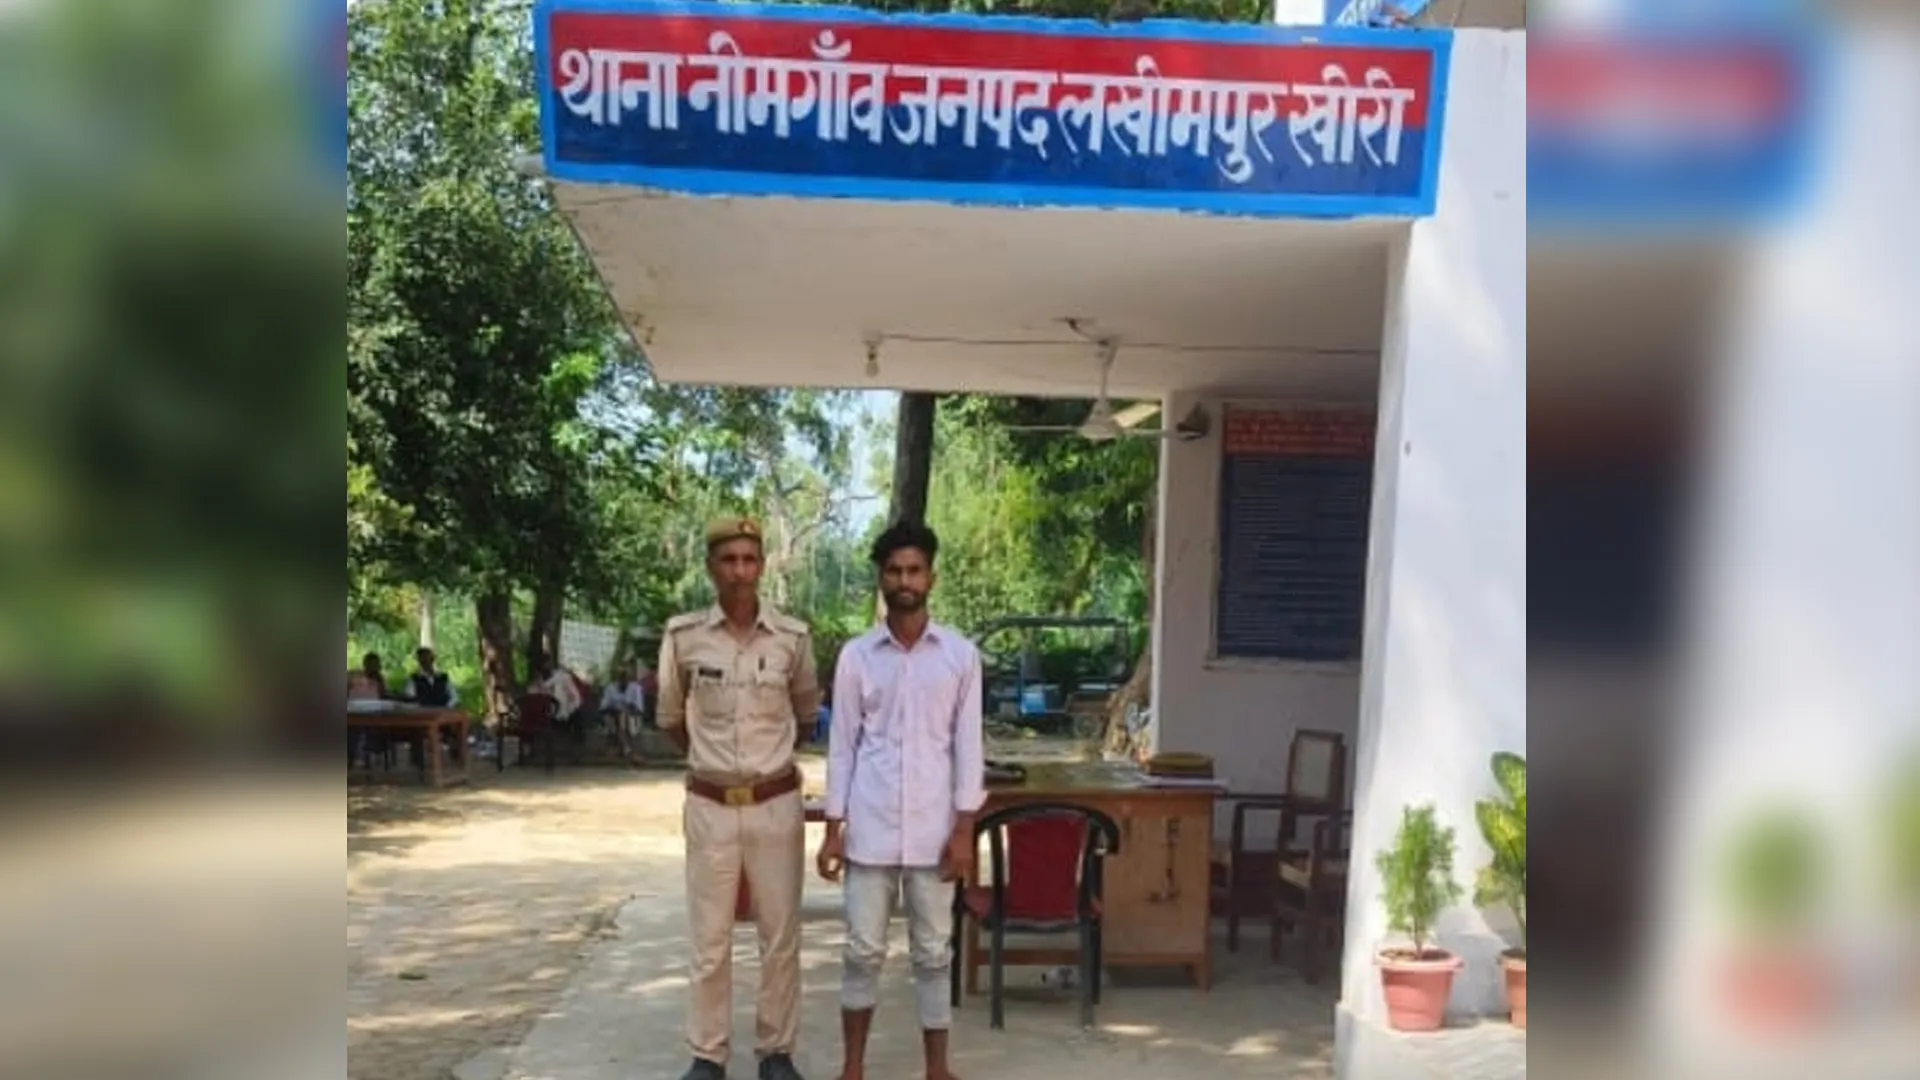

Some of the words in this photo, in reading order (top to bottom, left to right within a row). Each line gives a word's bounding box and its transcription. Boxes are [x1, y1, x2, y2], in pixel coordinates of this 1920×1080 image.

[559, 48, 683, 130] थाना
[688, 30, 889, 144] नीमगाँव
[887, 64, 1058, 161] जनपद
[1056, 55, 1288, 183] लखीमपुर
[1288, 64, 1415, 168] खीरी
